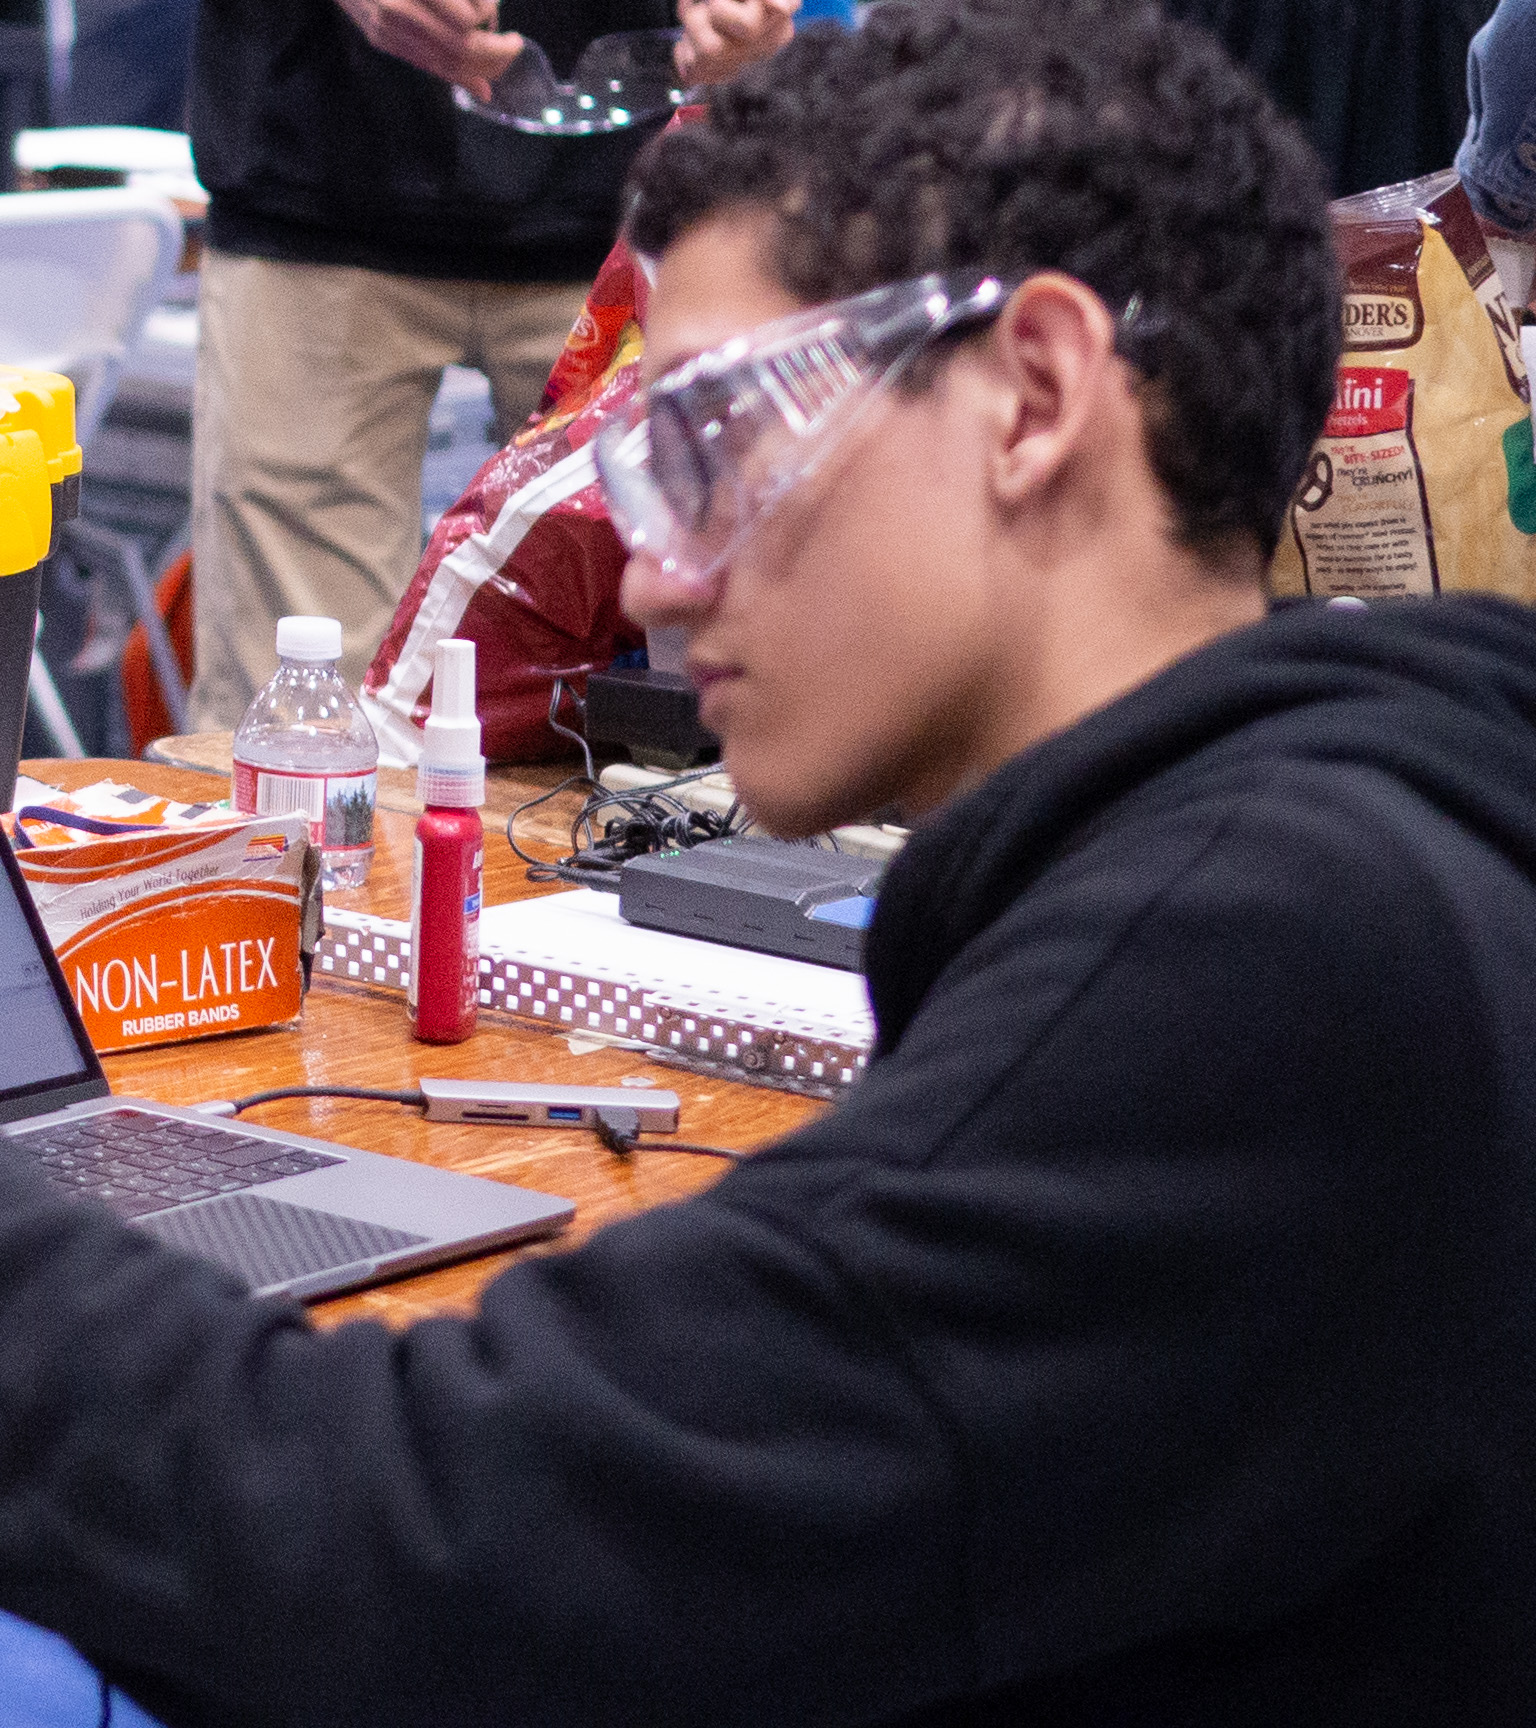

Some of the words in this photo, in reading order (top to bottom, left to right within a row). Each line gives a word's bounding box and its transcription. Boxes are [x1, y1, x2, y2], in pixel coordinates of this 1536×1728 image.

[1345, 301, 1408, 327] DER'S
[80, 896, 116, 920] Holding
[118, 885, 140, 902] Your
[143, 874, 172, 890] World
[176, 864, 220, 884] Together
[76, 936, 279, 1015] NON-LATEX
[121, 1012, 186, 1038] RUBBER
[188, 1003, 241, 1029] BANDS
